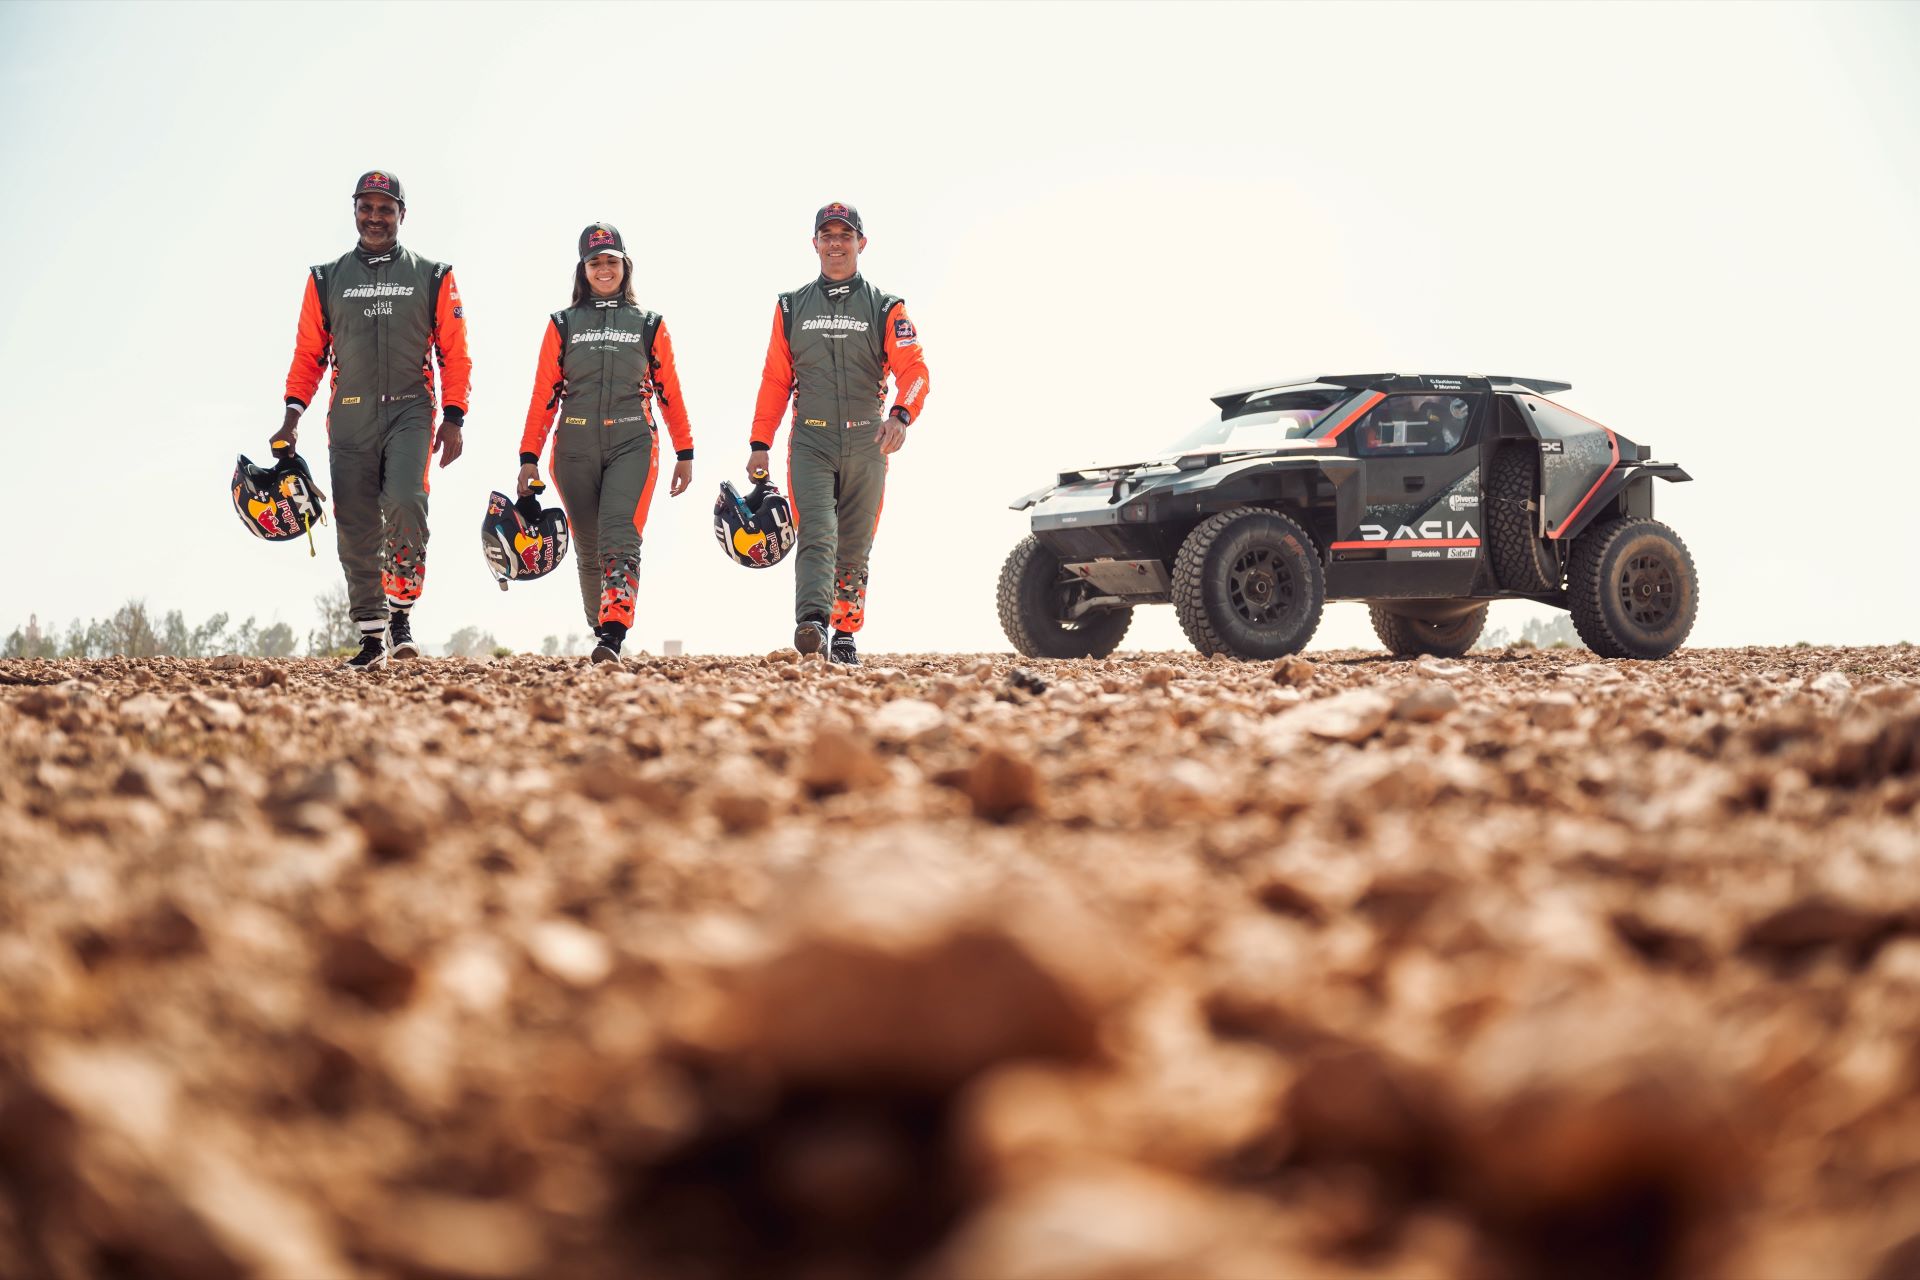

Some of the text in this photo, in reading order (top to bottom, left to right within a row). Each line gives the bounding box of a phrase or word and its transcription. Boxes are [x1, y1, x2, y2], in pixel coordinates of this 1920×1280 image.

[342, 286, 415, 298] SANDRIDERS
[372, 300, 393, 309] visit
[363, 307, 393, 318] QATAR
[801, 319, 869, 332] SANDRIDERS
[571, 331, 641, 344] SANDRIDERS
[1360, 520, 1480, 540] DACIA
[1450, 548, 1473, 557] Sabelt
